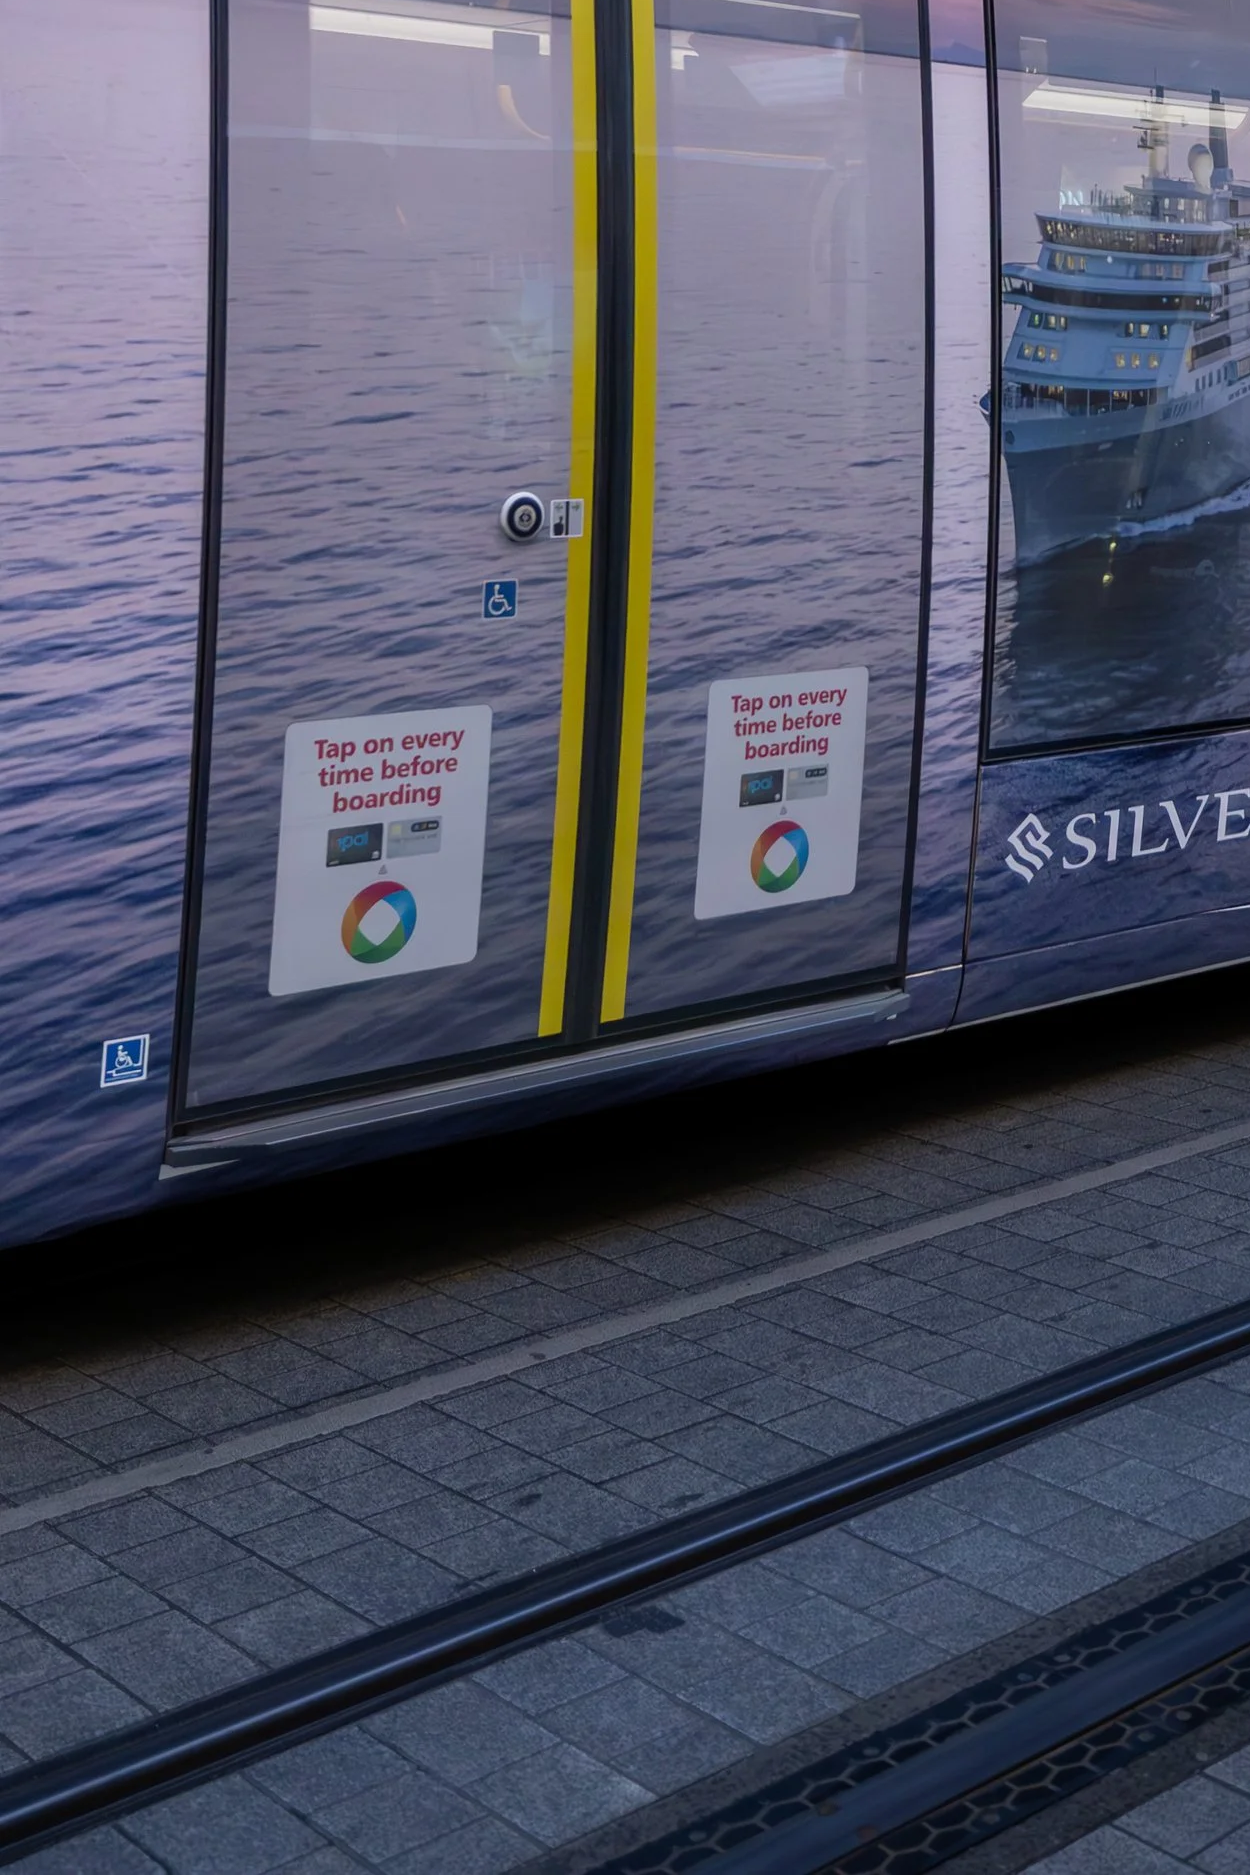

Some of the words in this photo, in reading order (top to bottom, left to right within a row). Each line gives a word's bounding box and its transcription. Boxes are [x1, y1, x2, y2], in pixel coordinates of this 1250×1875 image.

[731, 694, 763, 716] Tap
[769, 692, 793, 709] on
[798, 688, 847, 706] every
[734, 718, 777, 737] time
[782, 711, 842, 731] before
[314, 738, 356, 762] Tap
[363, 735, 394, 755] on
[401, 729, 465, 751] every
[744, 735, 829, 760] boarding
[318, 765, 374, 787] time
[381, 757, 458, 781] before
[332, 783, 442, 813] boarding
